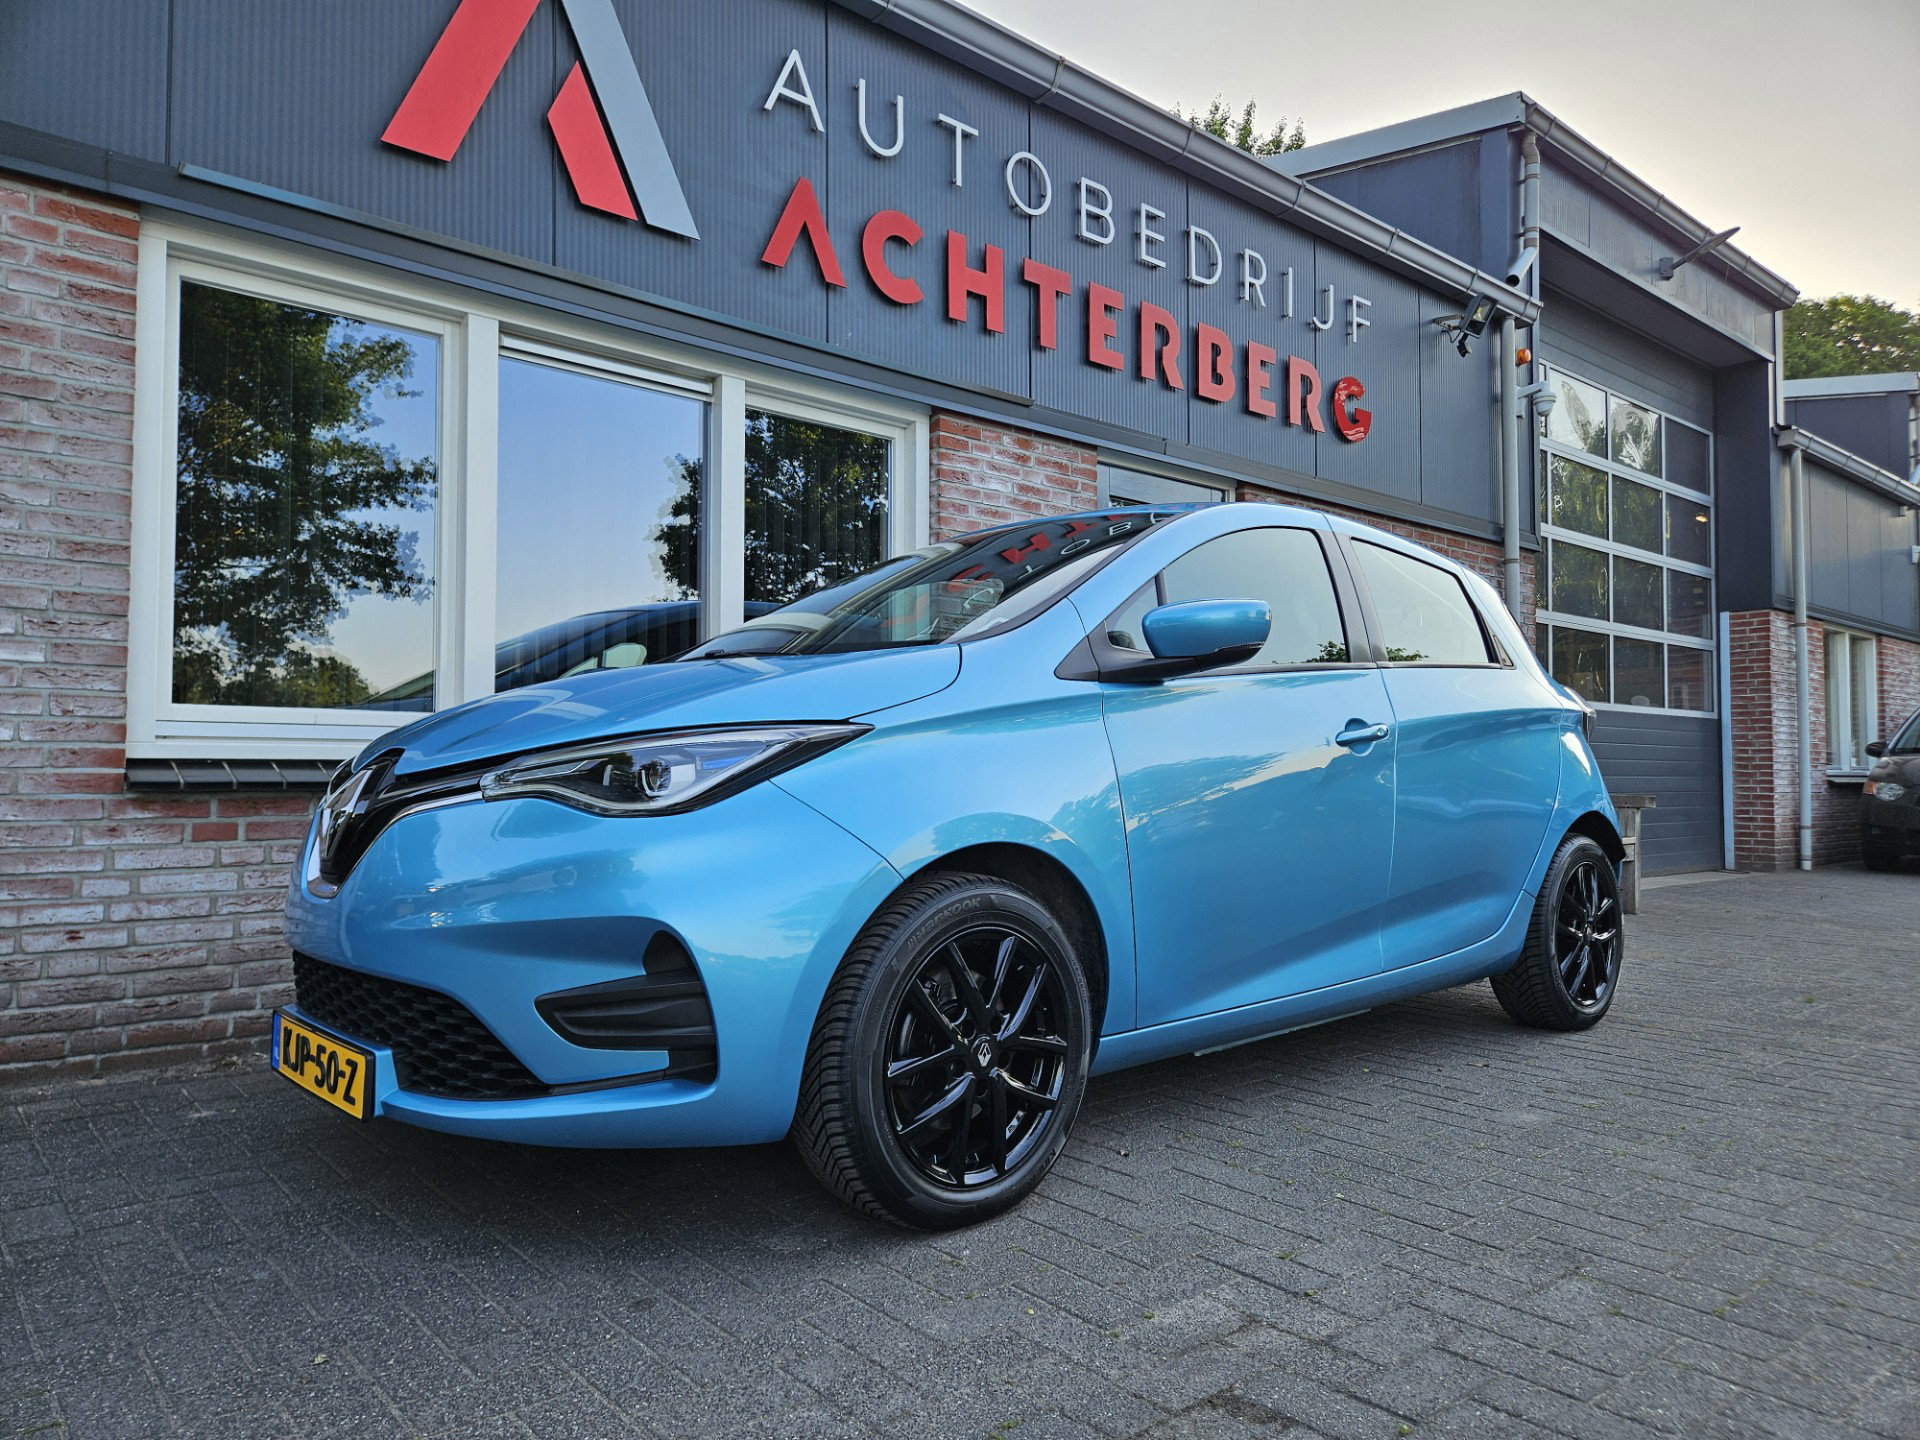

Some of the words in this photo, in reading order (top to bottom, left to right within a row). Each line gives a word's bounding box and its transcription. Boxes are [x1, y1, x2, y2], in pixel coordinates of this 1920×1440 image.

[761, 177, 1372, 443] ACHTERBERG
[764, 49, 1372, 343] AUTOBEDRIJF
[283, 1026, 358, 1106] KJP-50-Z
